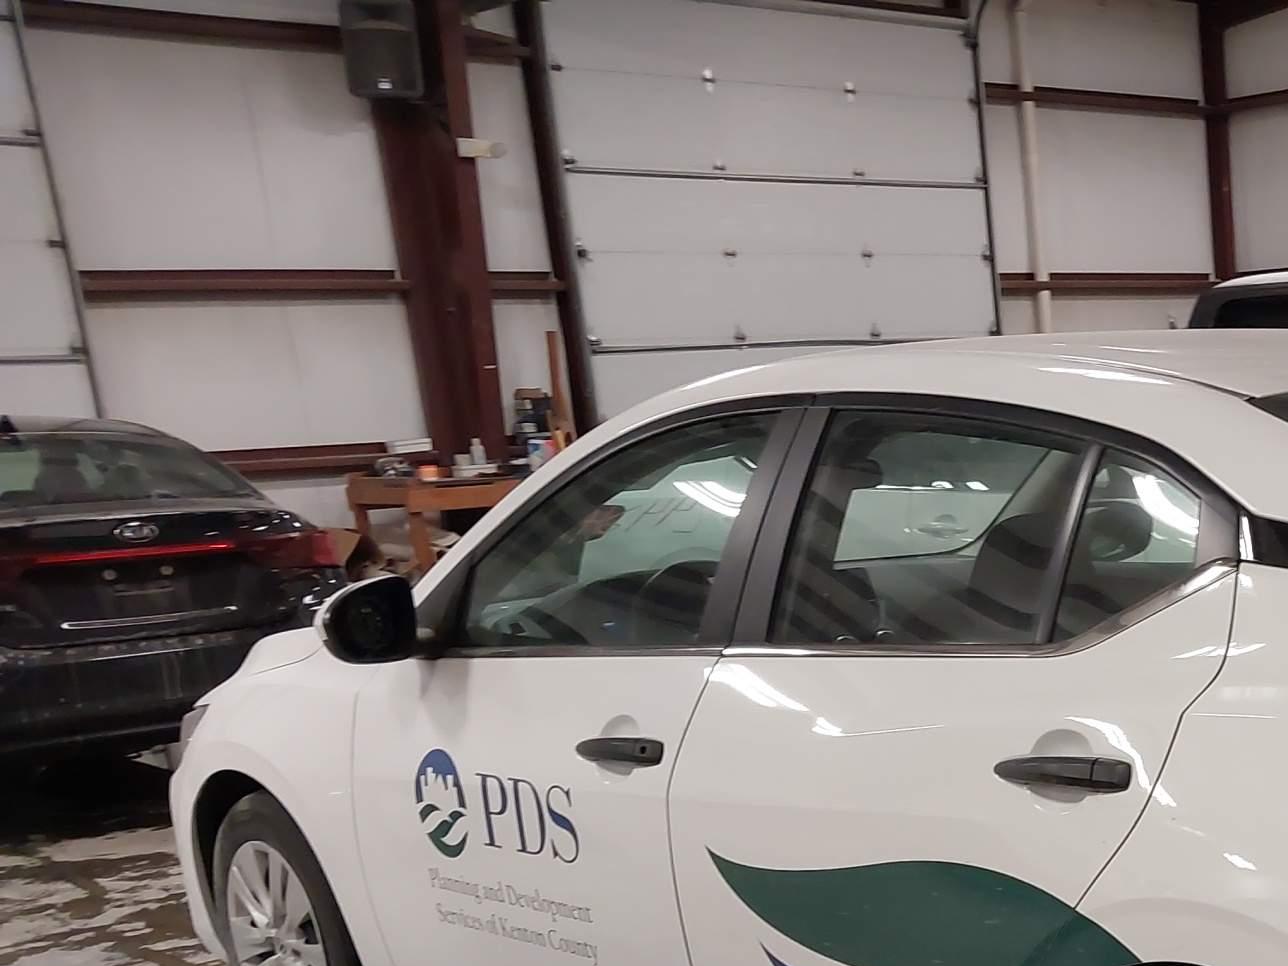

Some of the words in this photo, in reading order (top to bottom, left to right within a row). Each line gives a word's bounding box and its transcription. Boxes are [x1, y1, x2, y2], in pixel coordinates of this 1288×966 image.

[475, 772, 580, 864] PDS
[428, 867, 482, 904] Planning
[505, 884, 594, 923] Development
[436, 903, 484, 930] Services
[548, 929, 598, 966] County
